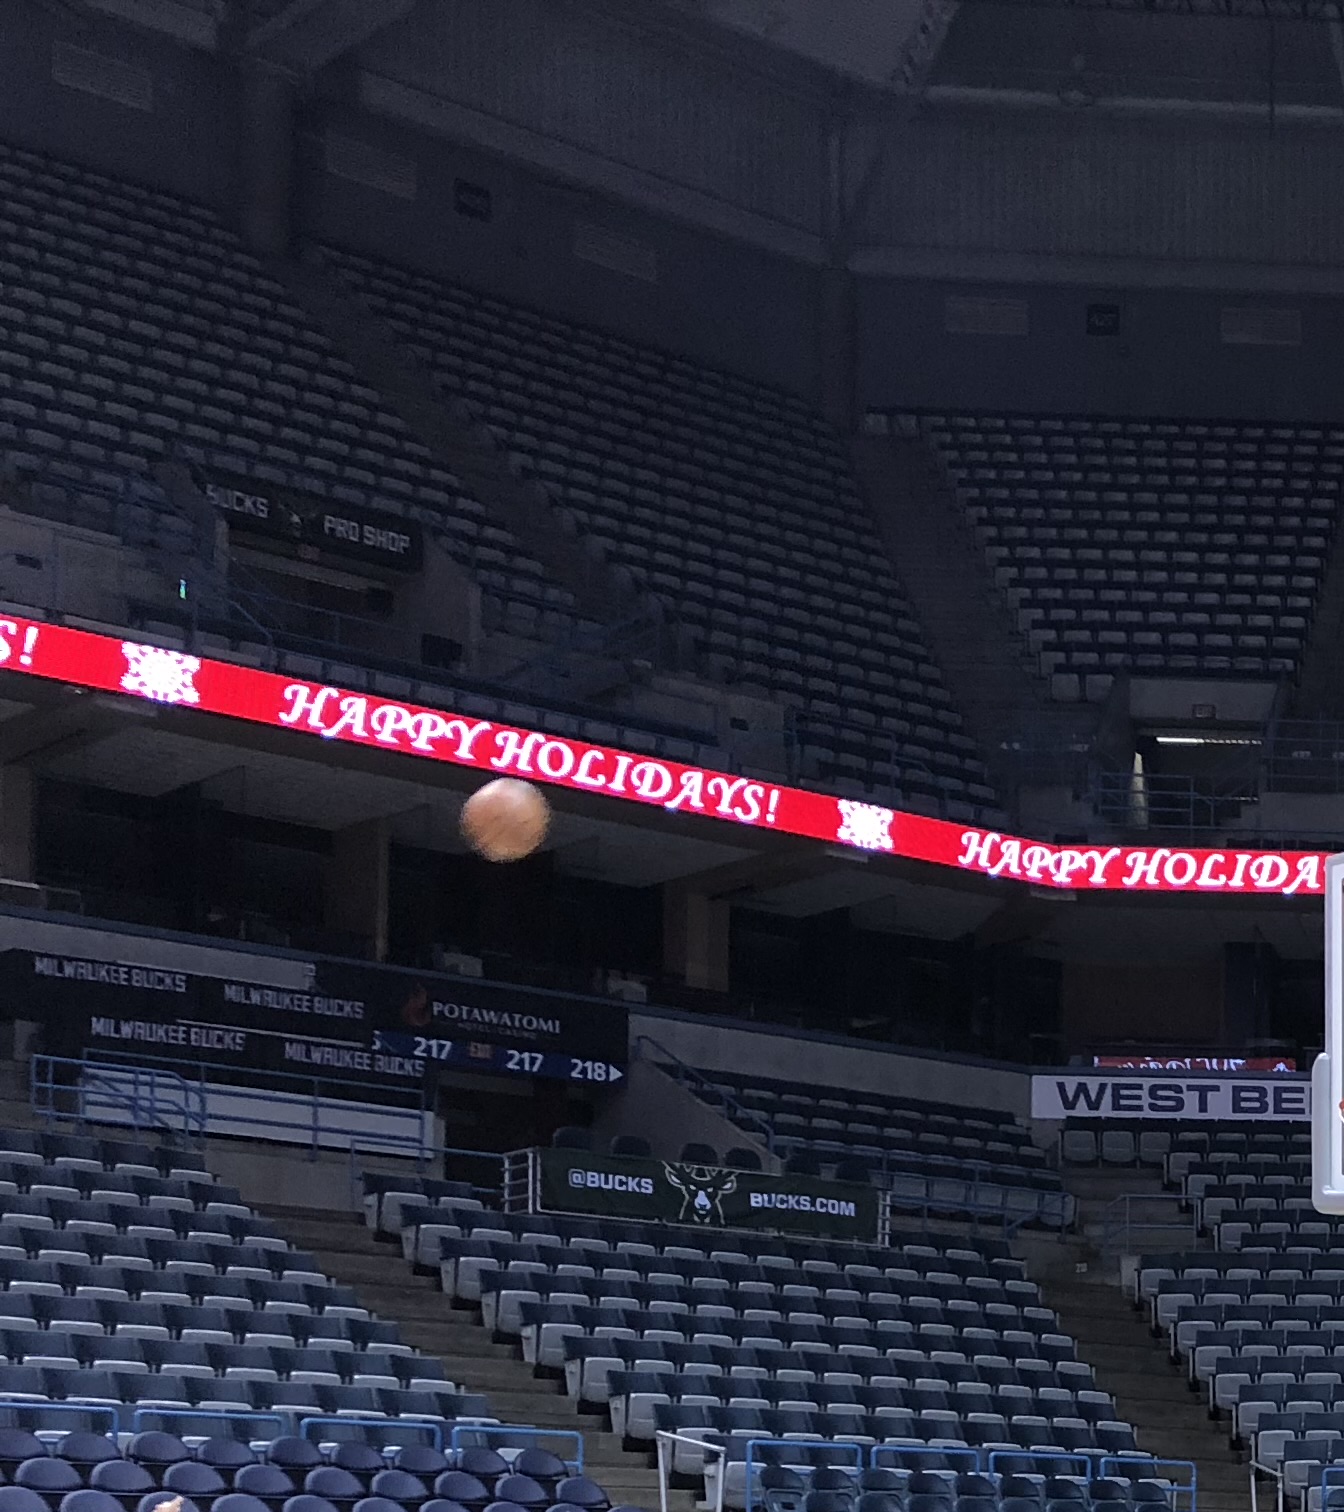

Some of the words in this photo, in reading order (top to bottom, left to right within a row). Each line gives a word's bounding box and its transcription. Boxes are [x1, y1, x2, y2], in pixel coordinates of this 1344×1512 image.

[323, 515, 359, 542] PRO
[363, 524, 410, 553] SHOP
[279, 684, 494, 759] HAPPY
[491, 730, 780, 824] HOLIDAYS!
[958, 831, 1122, 886] HAPPY
[1121, 848, 1322, 895] HOLIDA
[432, 1001, 560, 1034] POTAWATOMI
[413, 1036, 453, 1060] 217
[506, 1049, 544, 1073] 217
[570, 1058, 607, 1082] 218
[1056, 1081, 1221, 1114] WEST
[1231, 1083, 1311, 1115] BE
[568, 1168, 653, 1194] @BUCKS
[749, 1192, 855, 1217] BUCKS.COM
